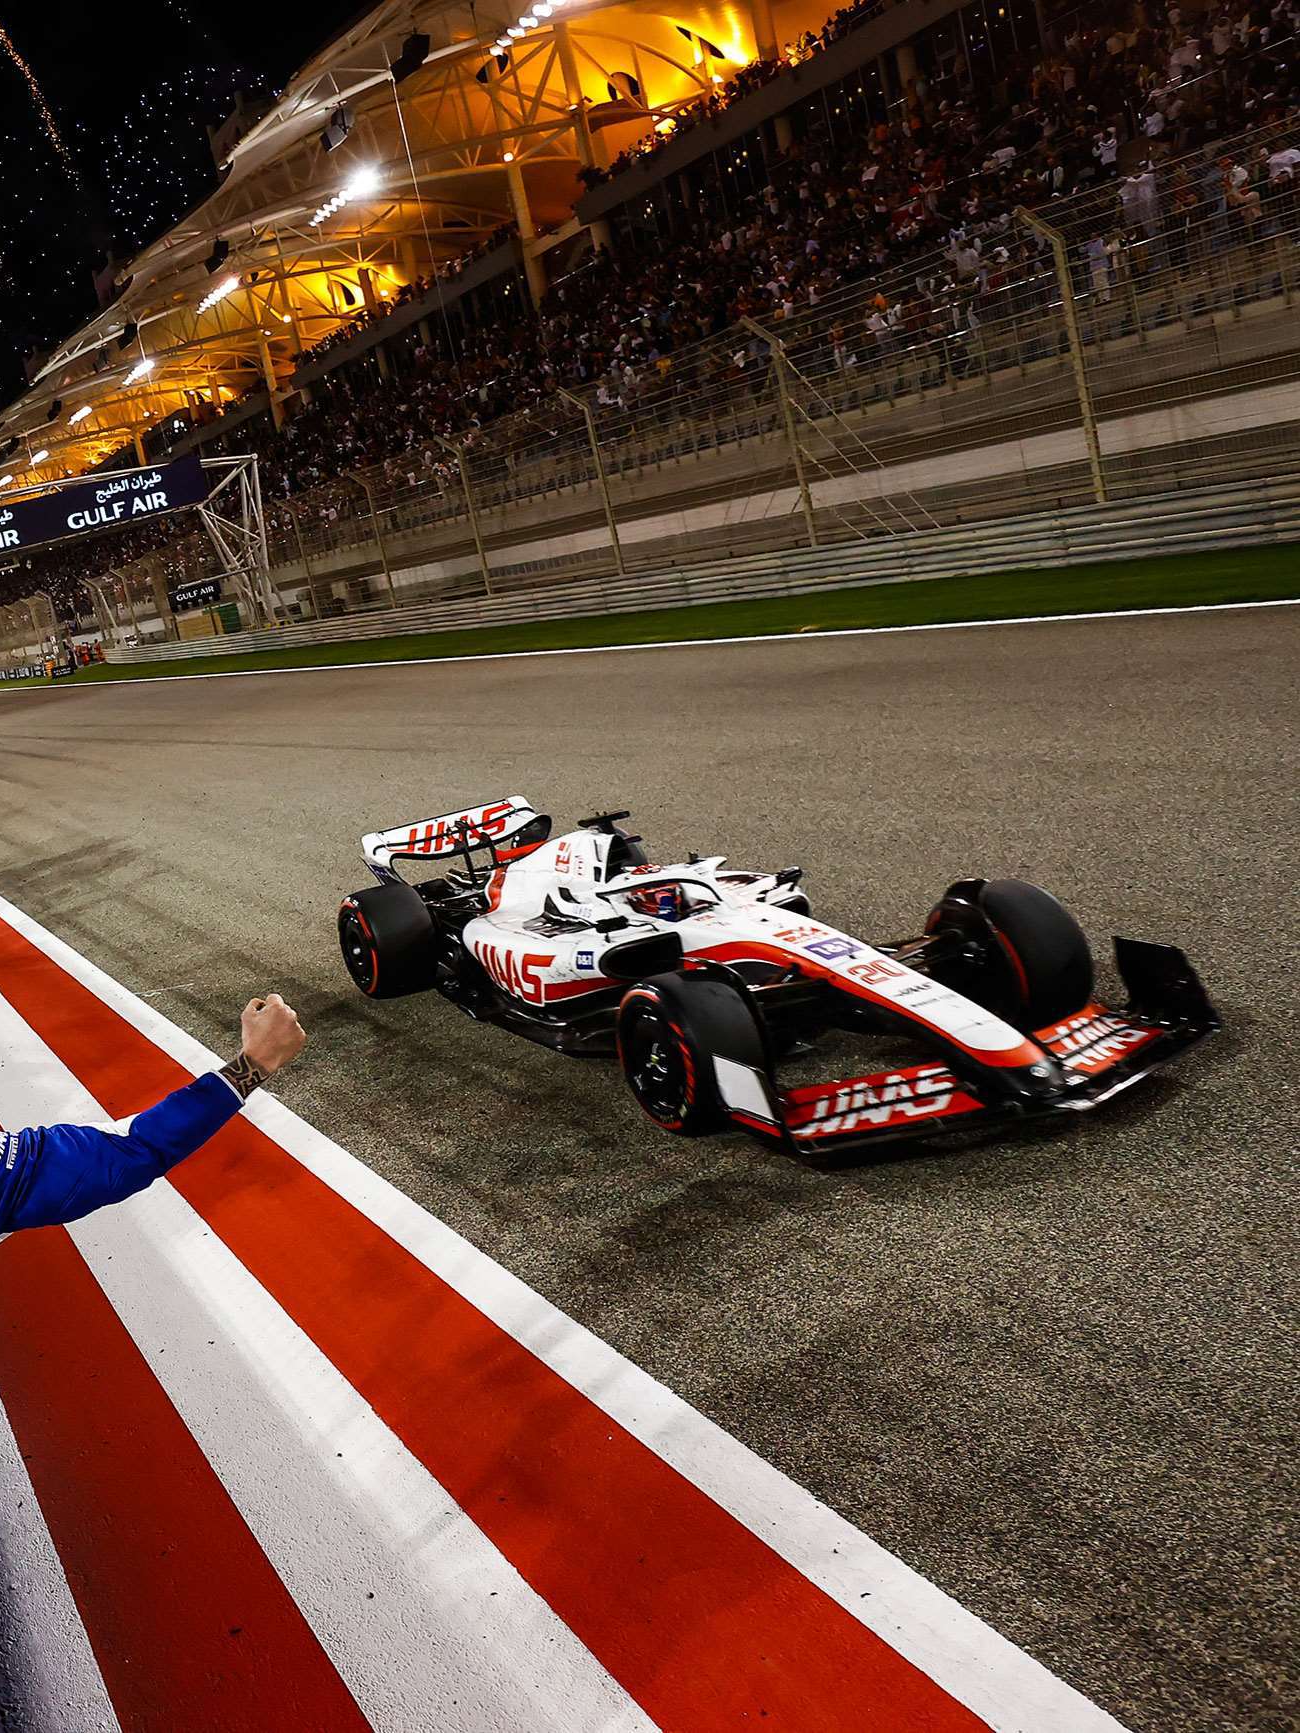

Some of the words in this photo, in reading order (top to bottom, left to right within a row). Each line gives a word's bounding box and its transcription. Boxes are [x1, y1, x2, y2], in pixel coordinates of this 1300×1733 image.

[95, 480, 130, 503] الخليج
[130, 471, 162, 491] طيران
[67, 501, 126, 530] GULF
[131, 491, 169, 515] AIR
[176, 589, 198, 602] GULF
[200, 585, 214, 595] AIR
[387, 803, 515, 854] HAAS
[474, 940, 556, 1006] HAAS
[847, 960, 909, 985] 20
[1042, 1014, 1149, 1067] HAAS
[790, 1066, 955, 1136] HAAS
